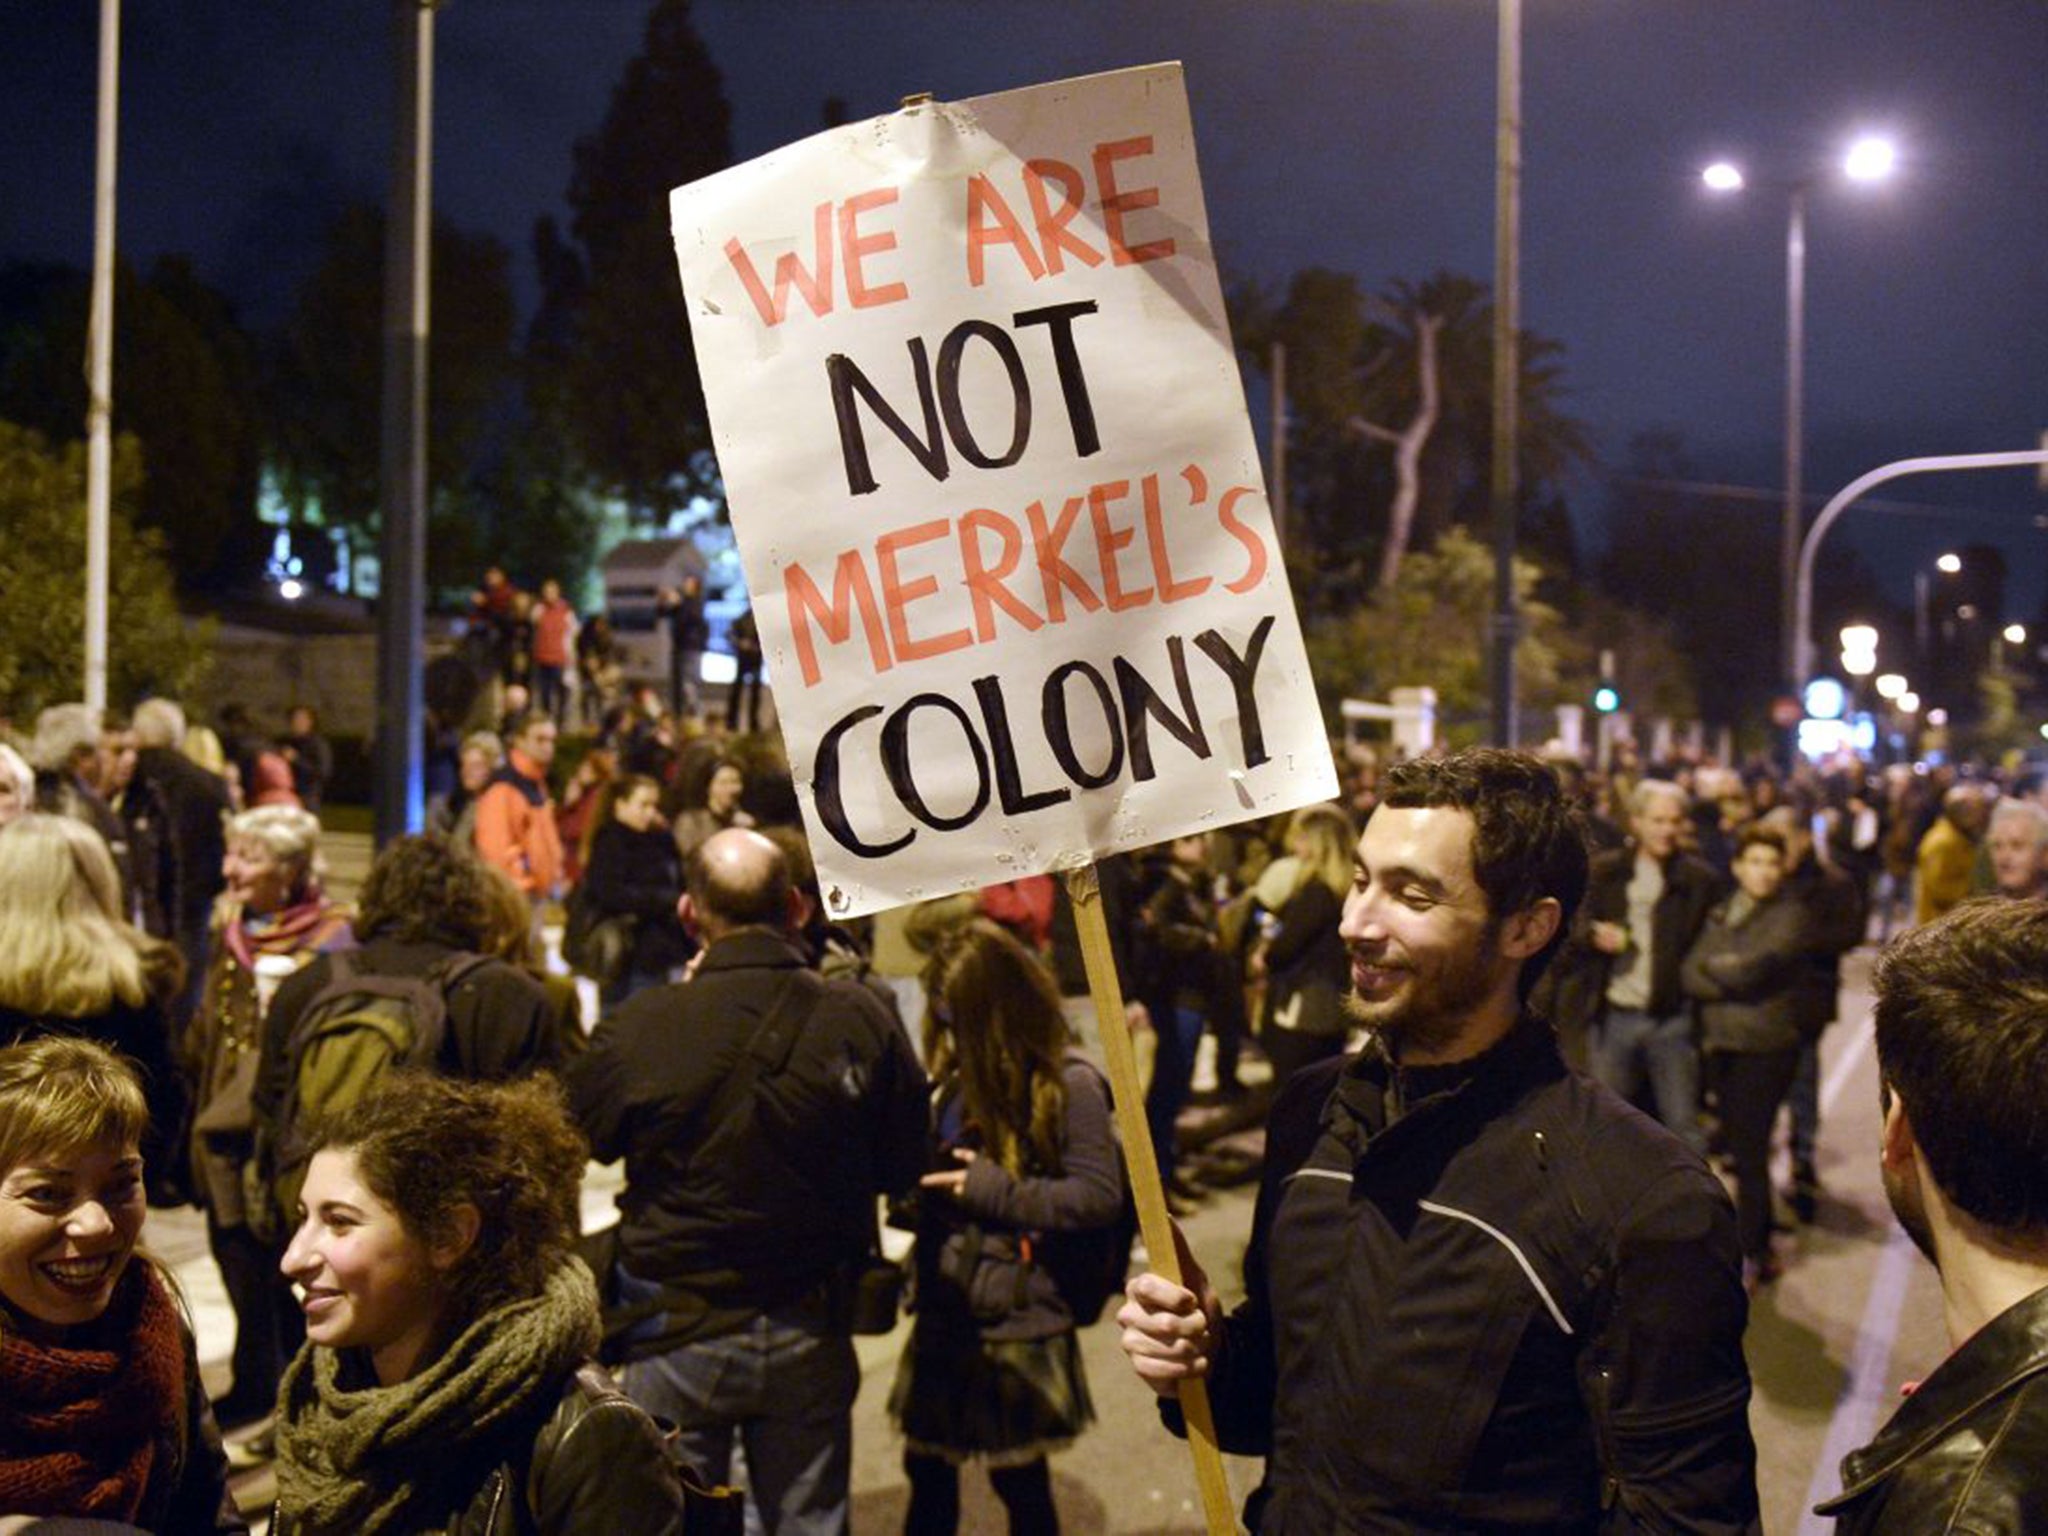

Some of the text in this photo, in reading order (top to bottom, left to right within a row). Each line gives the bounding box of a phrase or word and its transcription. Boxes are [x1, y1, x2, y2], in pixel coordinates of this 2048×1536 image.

[724, 136, 1177, 327] WE ARE
[825, 299, 1099, 496] NOT
[783, 463, 1268, 688] MERKEL'S
[812, 616, 1276, 858] COLONY
